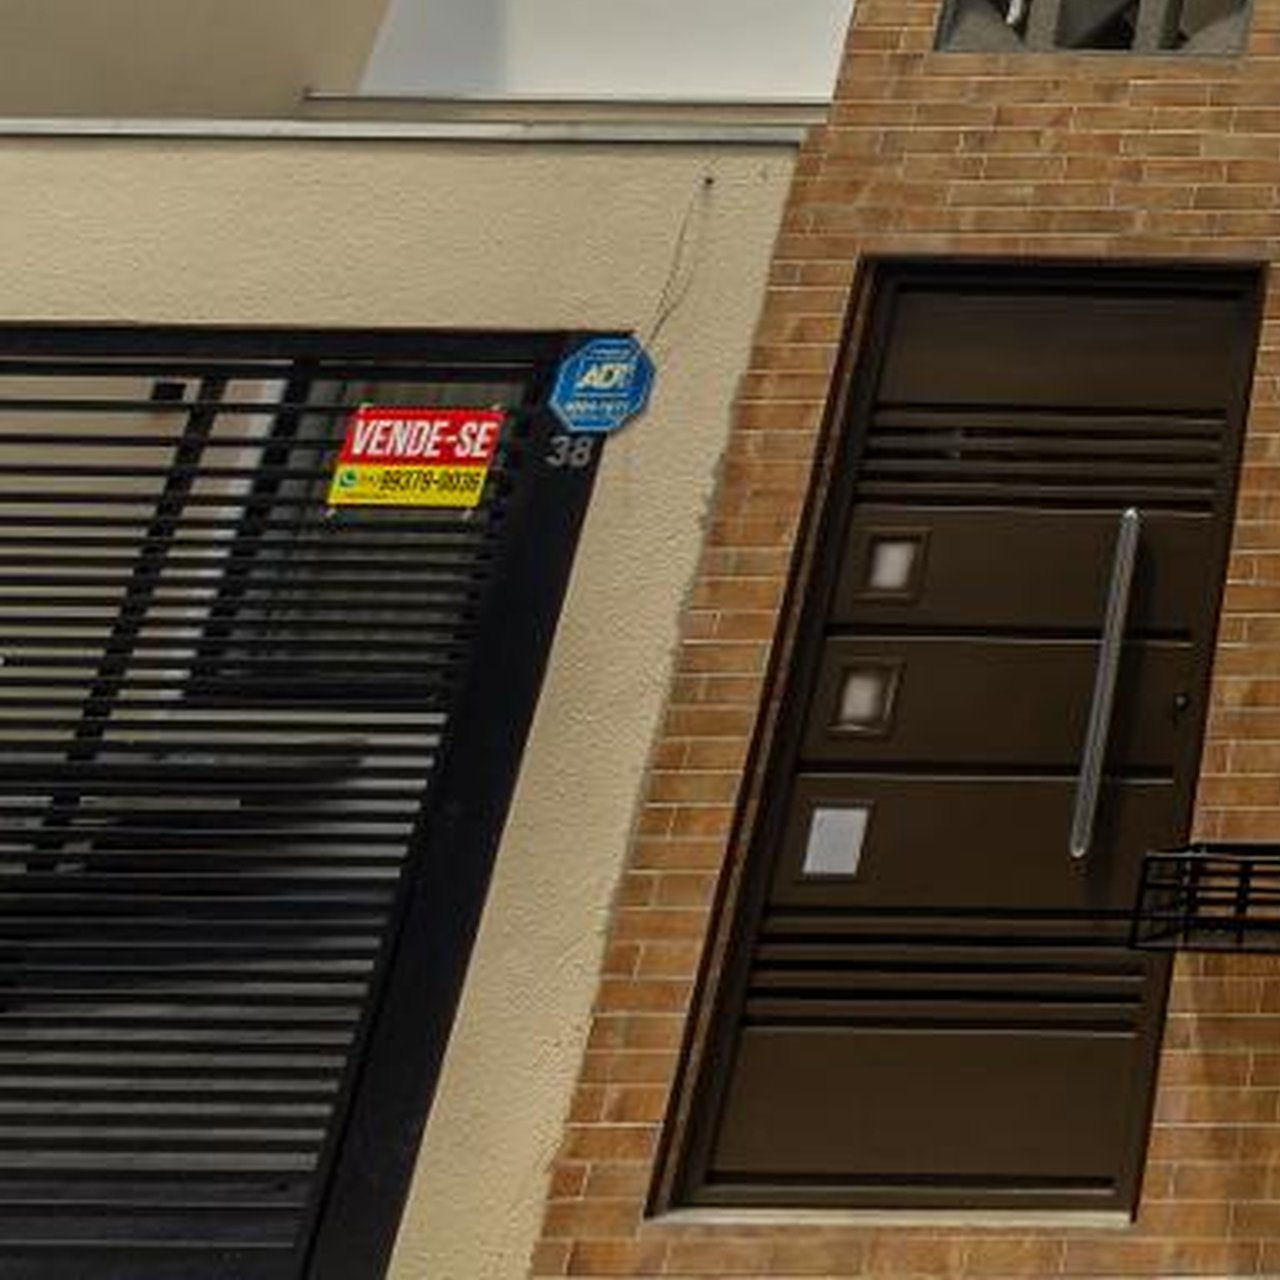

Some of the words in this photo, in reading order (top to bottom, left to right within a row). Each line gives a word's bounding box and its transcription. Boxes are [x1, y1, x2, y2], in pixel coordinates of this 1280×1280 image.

[575, 361, 630, 389] ADT
[352, 419, 499, 457] VENDE-SE
[546, 436, 592, 467] 38
